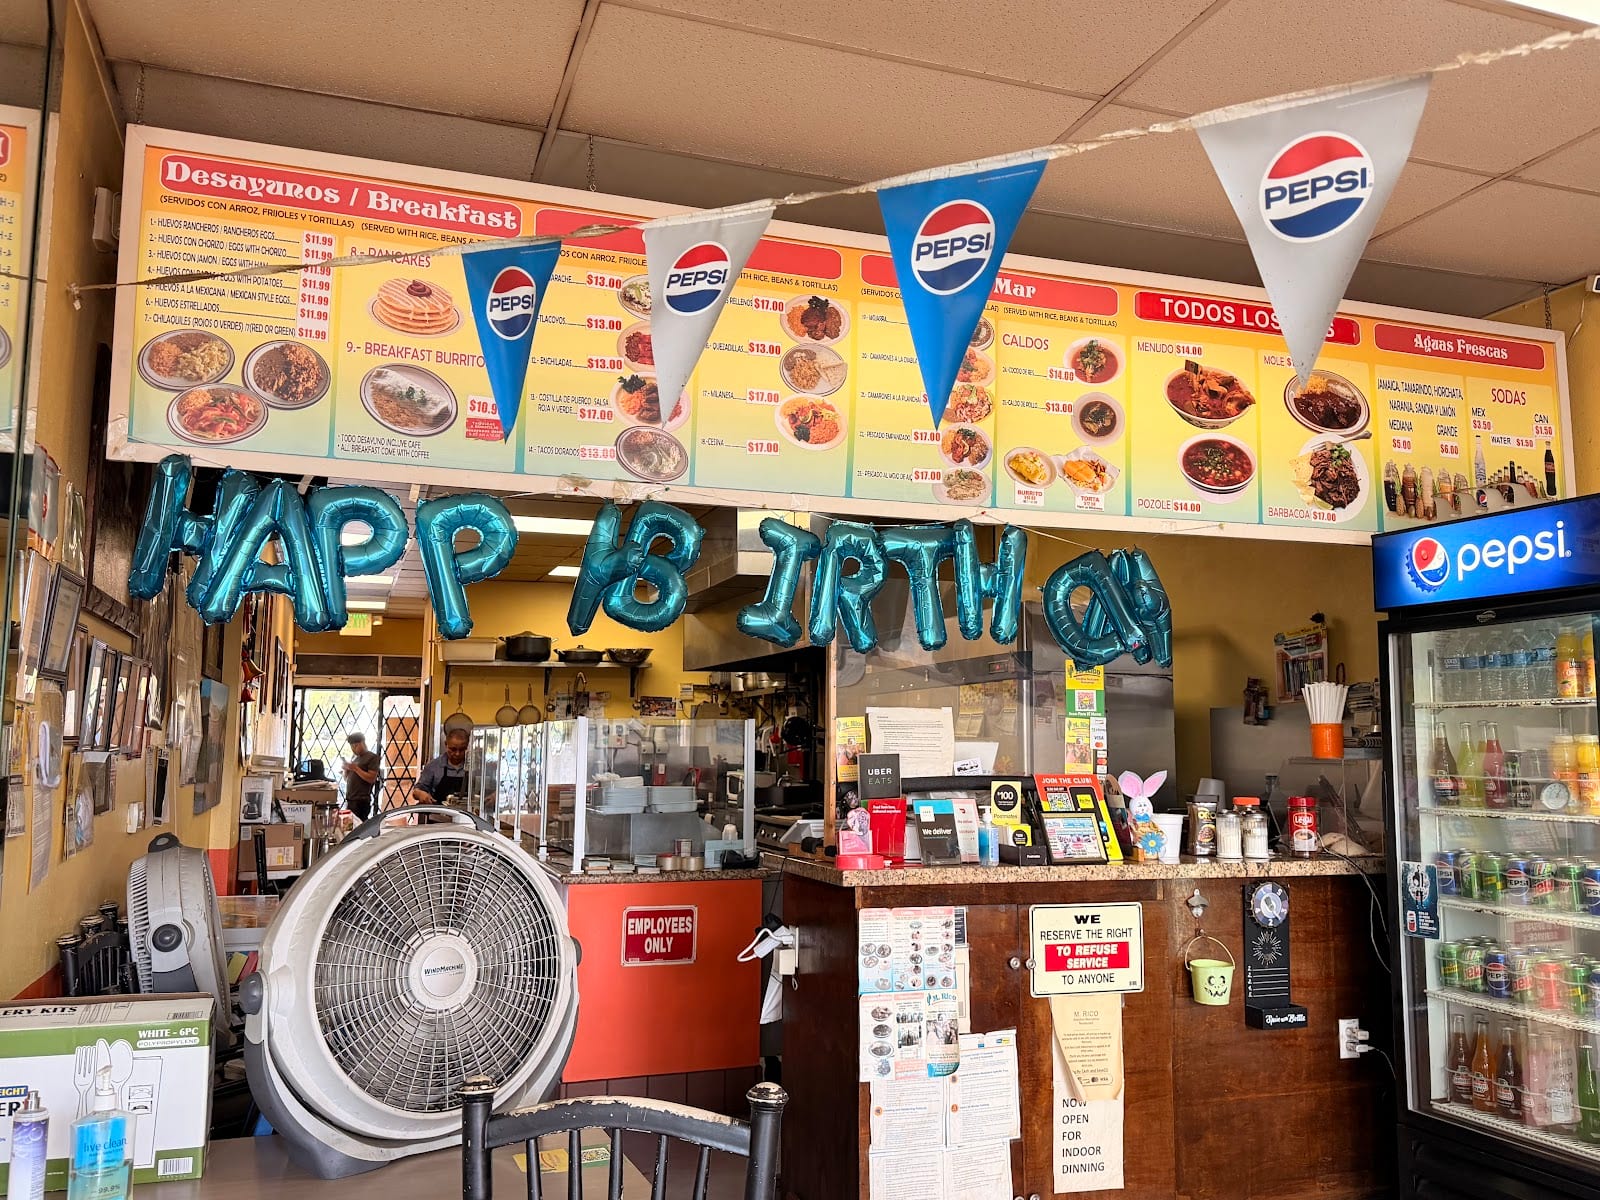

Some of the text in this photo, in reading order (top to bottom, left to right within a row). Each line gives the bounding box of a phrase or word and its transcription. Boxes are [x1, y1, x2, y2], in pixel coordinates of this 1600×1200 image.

[1264, 167, 1367, 210] PEPSI
[166, 161, 517, 231] Desayunos / Breakfast
[160, 195, 355, 229] (SERVIDOS CON ARROZ, FRIJOLES TORTILLAS)
[157, 218, 275, 241] HUEVOS RANCHEROS RANCHEROS EGGS
[361, 222, 465, 244] (SERVED WITH RICE, BEANS
[158, 234, 287, 257] HUEVOS CON CHORIZO EGGS WITH CHORIZO
[305, 232, 334, 247] $11.99
[915, 232, 991, 261] PEPSI
[304, 247, 333, 261] $11.99
[572, 251, 617, 264] CON ARROZ,
[303, 264, 331, 278] $11.99
[302, 278, 330, 292] $11.99
[586, 274, 622, 290] $13.00
[666, 269, 728, 289] PEPSI
[753, 274, 838, 292] RICE, BEANS TORTILLAS)
[186, 285, 291, 305] LA MEXICANA MEXICAN STYLE EGGS
[861, 287, 893, 298] (SERVIDOS
[993, 277, 1037, 299] Mar
[154, 298, 220, 314] HUEVOS ESTRELLADOS
[301, 293, 329, 307] $11.99
[489, 293, 534, 313] PEPSI
[729, 297, 753, 308] RELLENOS
[754, 298, 784, 312] $17.00
[300, 307, 328, 322] $11.99
[1003, 307, 1118, 329] (SERVED WITH RICE, BEANS TORTILLAS)
[1160, 297, 1281, 330] TODOS LOS
[153, 314, 296, 338] CHILAQUILES VERDES) GREEN)
[586, 317, 622, 332] $13.00
[298, 326, 327, 341] $11.99
[748, 342, 781, 356] $13.00
[1002, 334, 1049, 351] CALDOS
[1137, 341, 1174, 354] MENUDO
[1413, 333, 1508, 361] Aguas Frescas
[364, 341, 485, 367] BREAKFAST BURRITO
[1176, 344, 1202, 357] $14.00
[540, 356, 572, 368] ENCHILADAS
[587, 358, 623, 371] $13.00
[1263, 356, 1285, 367] MOLE
[1048, 368, 1075, 382] $14.00
[748, 390, 780, 404] $17.00
[1401, 381, 1434, 397] TAMARINDO,
[1434, 385, 1464, 401] HORCHATA,
[1491, 388, 1527, 407] SODAS
[469, 399, 500, 414] $10.9
[1046, 401, 1073, 414] $13.00
[1472, 407, 1486, 418] MEX
[579, 407, 613, 422] $17.00
[1534, 413, 1549, 425] CAN
[1389, 419, 1413, 433] MEDIANA
[1437, 424, 1458, 438] GRANDE
[1472, 419, 1492, 432] $3.50
[1535, 425, 1553, 437] $1.50
[914, 431, 941, 443] $17.00
[1392, 438, 1411, 450] $5.00
[1491, 436, 1511, 447] WATER
[1516, 438, 1534, 450] $1.50
[340, 443, 430, 459] ALL BREAKFAST COME WITH COFFEE
[537, 445, 580, 458] TACOS DORADOS
[580, 445, 617, 460] $13.00
[748, 441, 779, 454] $17.00
[1440, 443, 1459, 456] $6.00
[914, 470, 941, 481] $17.00
[1080, 495, 1100, 504] TORTA
[1137, 498, 1171, 511] POZOLE
[1174, 501, 1201, 513] $14.00
[1267, 506, 1310, 520] BARBACOA
[1312, 510, 1337, 522] $17.00
[1457, 520, 1566, 582] pepsi
[867, 768, 893, 776] UBER
[868, 777, 893, 786] EATS
[1042, 777, 1093, 785] JOIN THE CLUB!
[997, 790, 1014, 801] $100
[922, 828, 952, 836] We deliver
[627, 916, 693, 935] EMPLOYEES
[1074, 914, 1101, 925] WE
[1040, 927, 1133, 941] RESERVE THE RIGHT
[644, 936, 674, 954] ONLY
[1056, 943, 1118, 957] TO REFUSE
[1066, 956, 1109, 970] SERVICE
[1061, 972, 1115, 985] TO ANYONE
[40, 1005, 78, 1015] KITS
[1082, 1010, 1099, 1018] RICO
[138, 1027, 199, 1039] WHITE 6PC
[138, 1039, 199, 1048] POLYPROPYLENE
[1062, 1098, 1088, 1109] NOW
[1062, 1114, 1089, 1125] OPEN
[1062, 1131, 1082, 1141] FOR
[84, 1136, 127, 1153] live clean
[1062, 1145, 1102, 1158] INDOOR
[1062, 1161, 1105, 1175] DINNING
